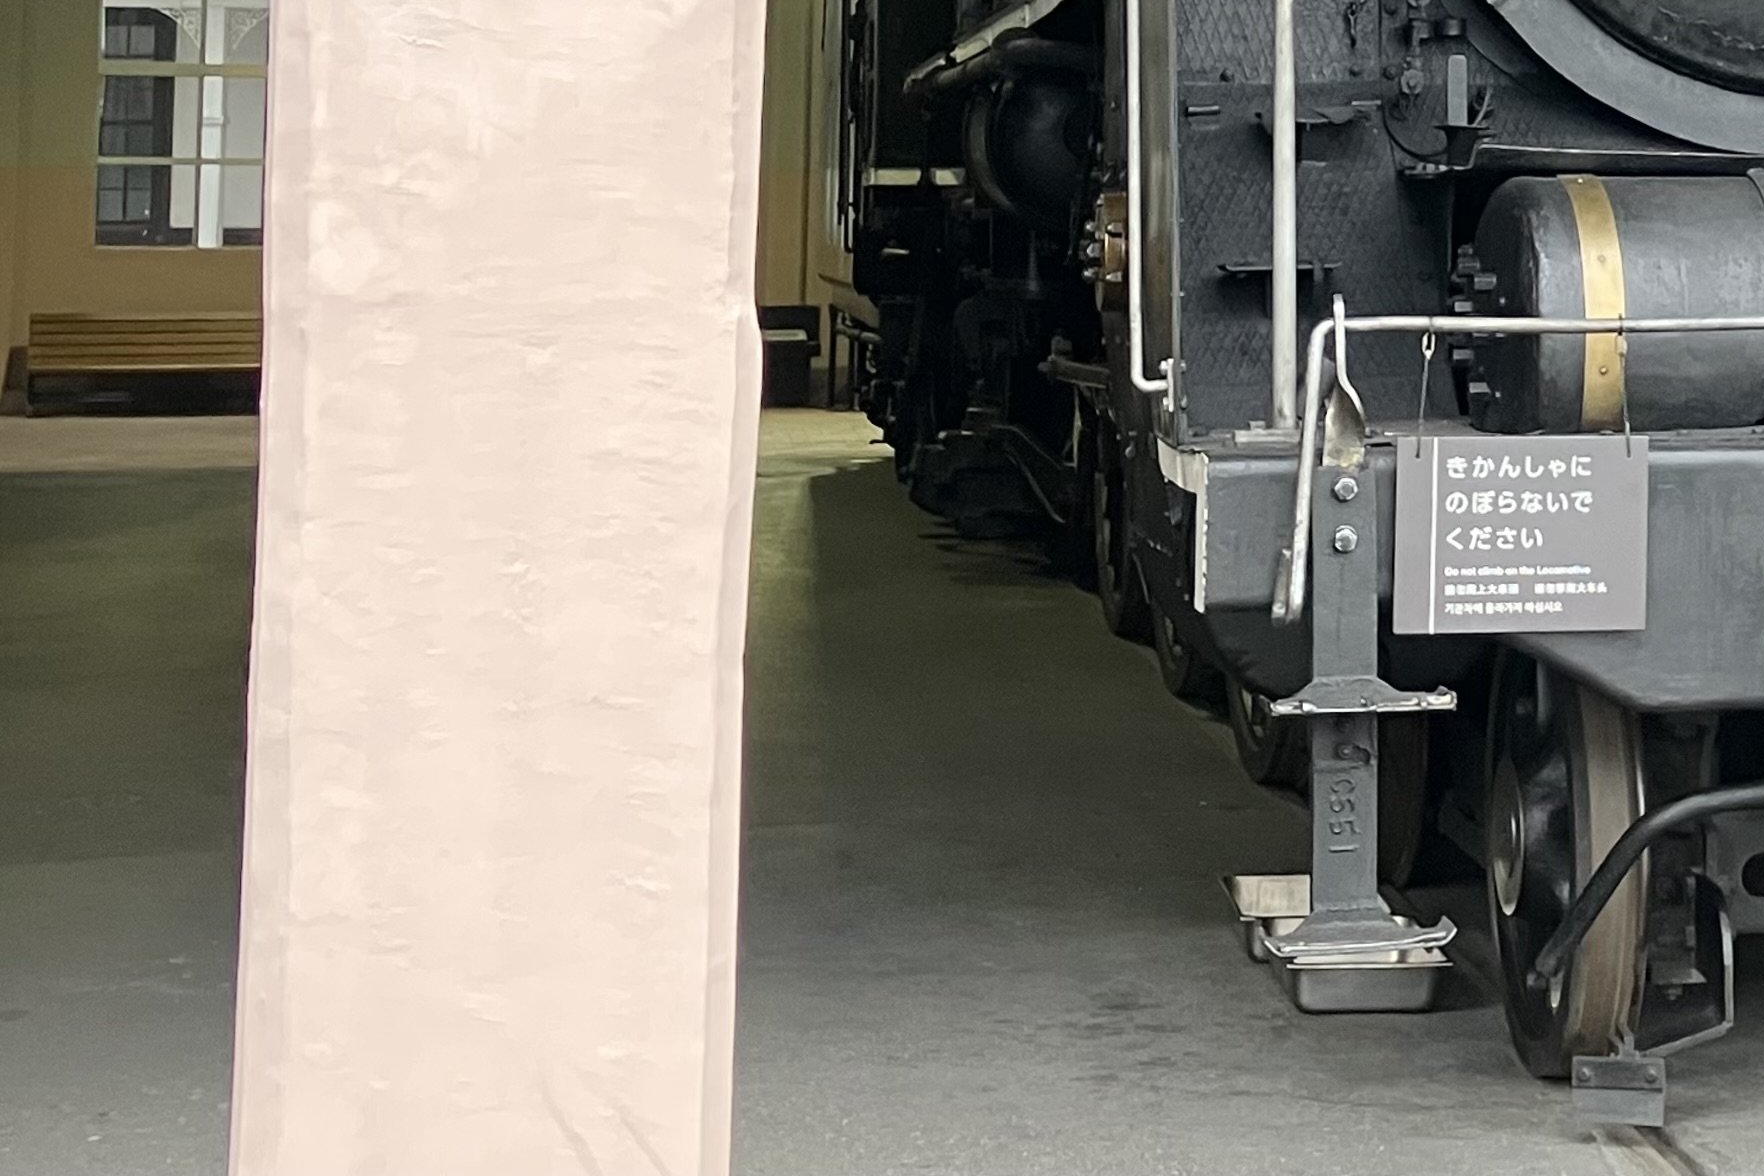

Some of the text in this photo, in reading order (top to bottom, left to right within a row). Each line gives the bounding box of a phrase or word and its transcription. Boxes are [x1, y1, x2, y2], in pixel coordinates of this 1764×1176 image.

[1446, 455, 1592, 479] きかんしゃに
[1445, 490, 1593, 515] のぼらないで
[1445, 526, 1544, 551] ください
[1444, 566, 1460, 577] Do
[1460, 566, 1477, 577] not
[1477, 566, 1504, 576] climb
[1505, 567, 1518, 576] on
[1519, 565, 1536, 576] the
